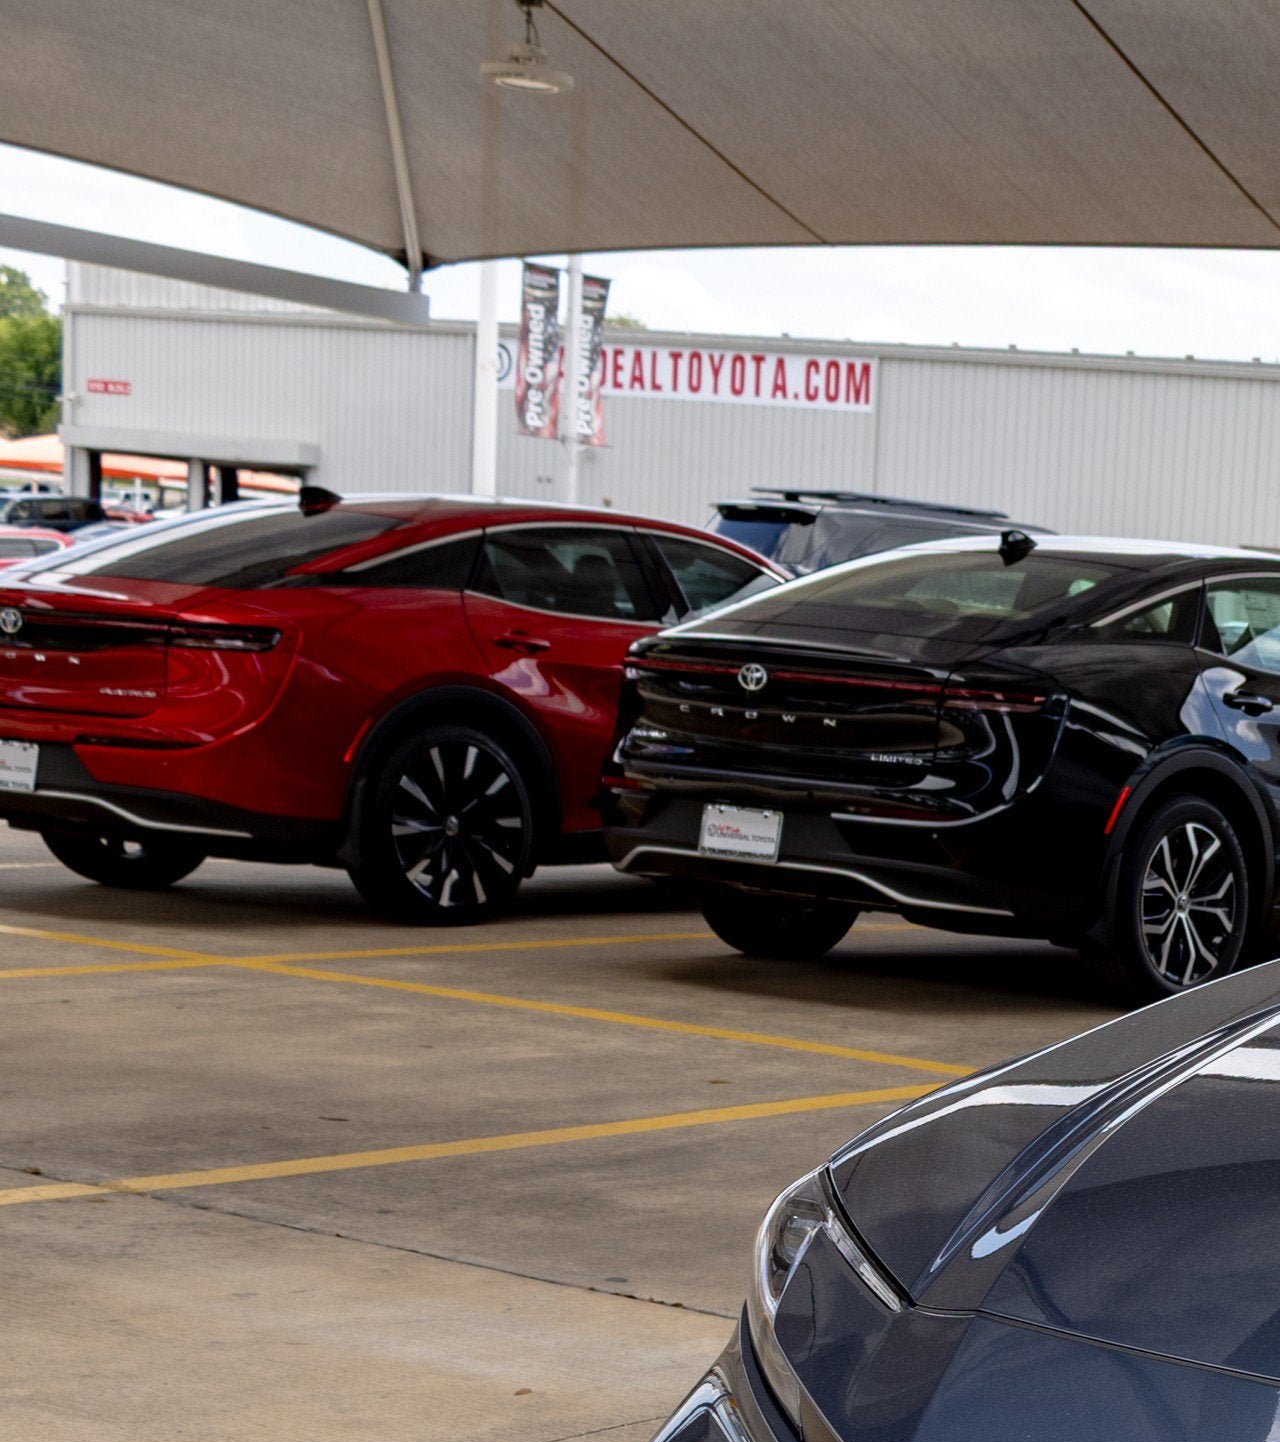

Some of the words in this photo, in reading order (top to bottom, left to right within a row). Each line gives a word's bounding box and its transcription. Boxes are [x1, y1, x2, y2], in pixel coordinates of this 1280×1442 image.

[524, 302, 546, 385] Owned
[525, 389, 545, 430] Pre
[870, 752, 923, 766] LIMITED
[751, 834, 775, 844] TOYOTA
